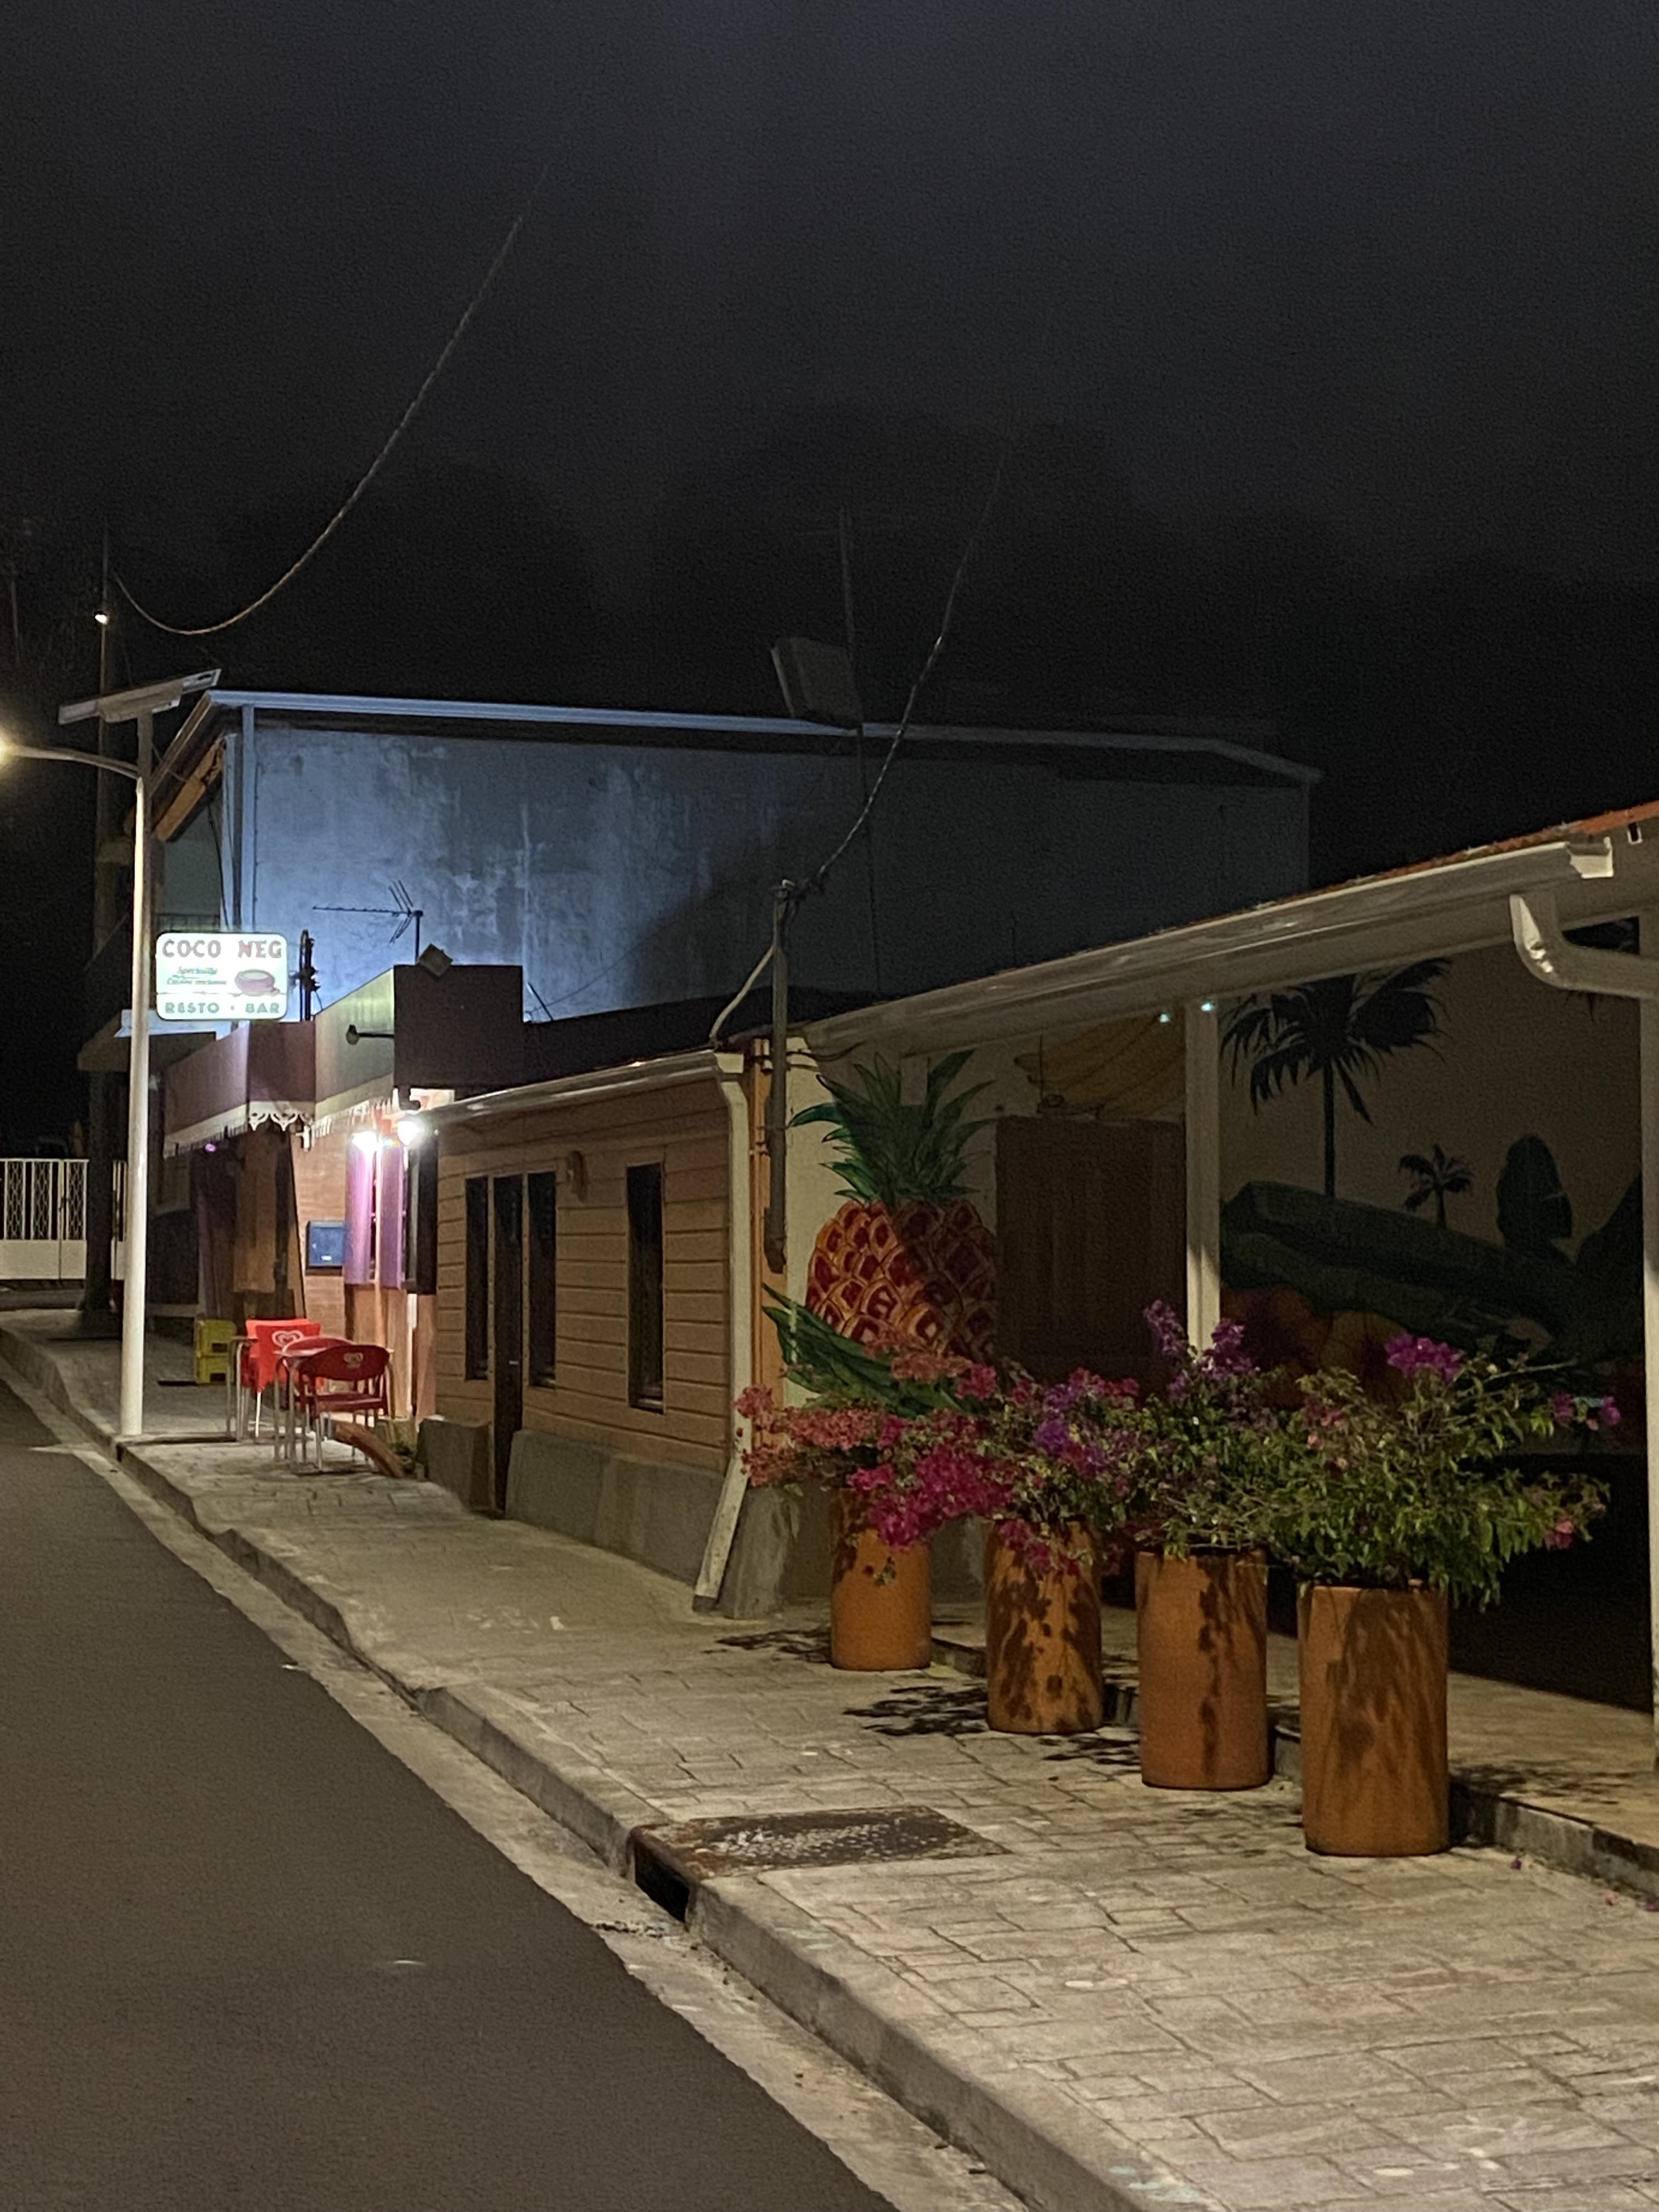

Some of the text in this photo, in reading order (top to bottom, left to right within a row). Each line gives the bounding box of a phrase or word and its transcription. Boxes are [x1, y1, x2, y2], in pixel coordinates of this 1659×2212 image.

[162, 939, 282, 958] COCO NEG
[165, 1002, 280, 1013] RESTO BAR
